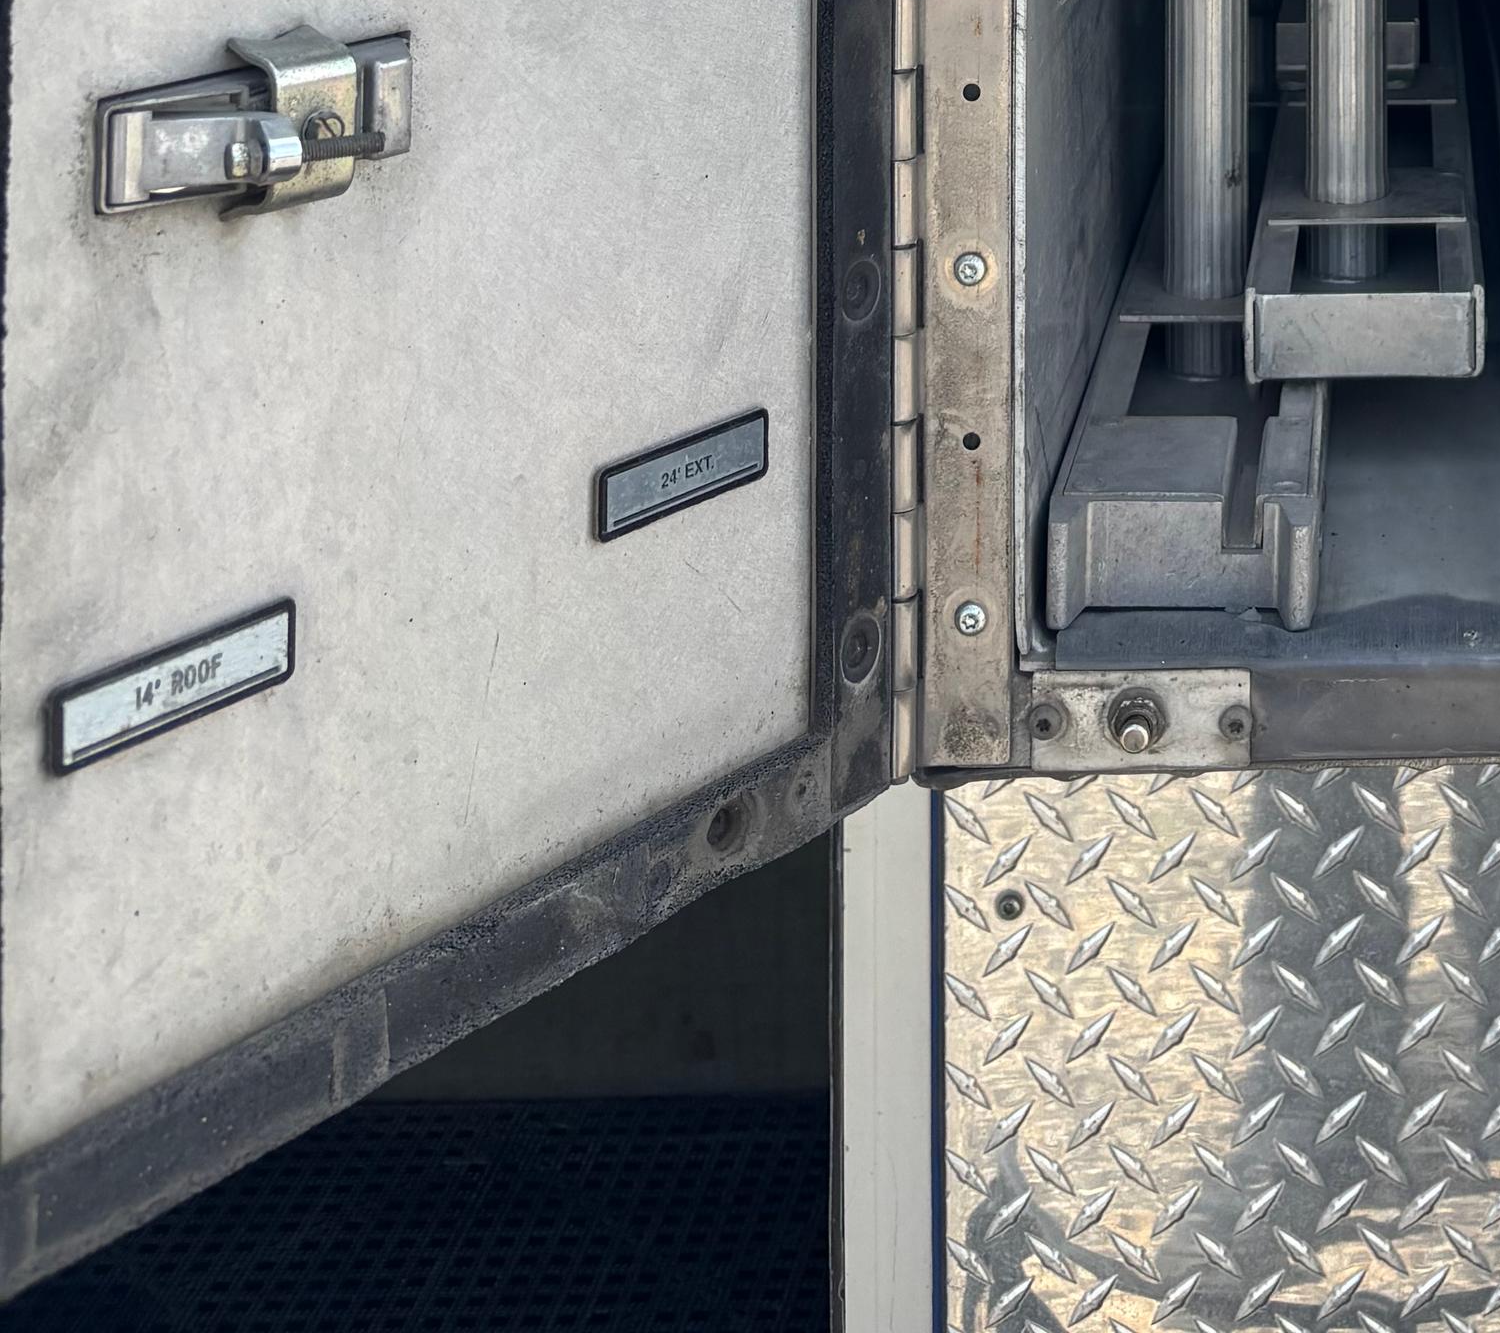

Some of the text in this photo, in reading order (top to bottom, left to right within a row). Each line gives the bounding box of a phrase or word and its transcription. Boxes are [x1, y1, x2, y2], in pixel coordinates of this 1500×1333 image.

[660, 454, 715, 490] 24' EXT.
[134, 652, 223, 711] 14' ROOF
